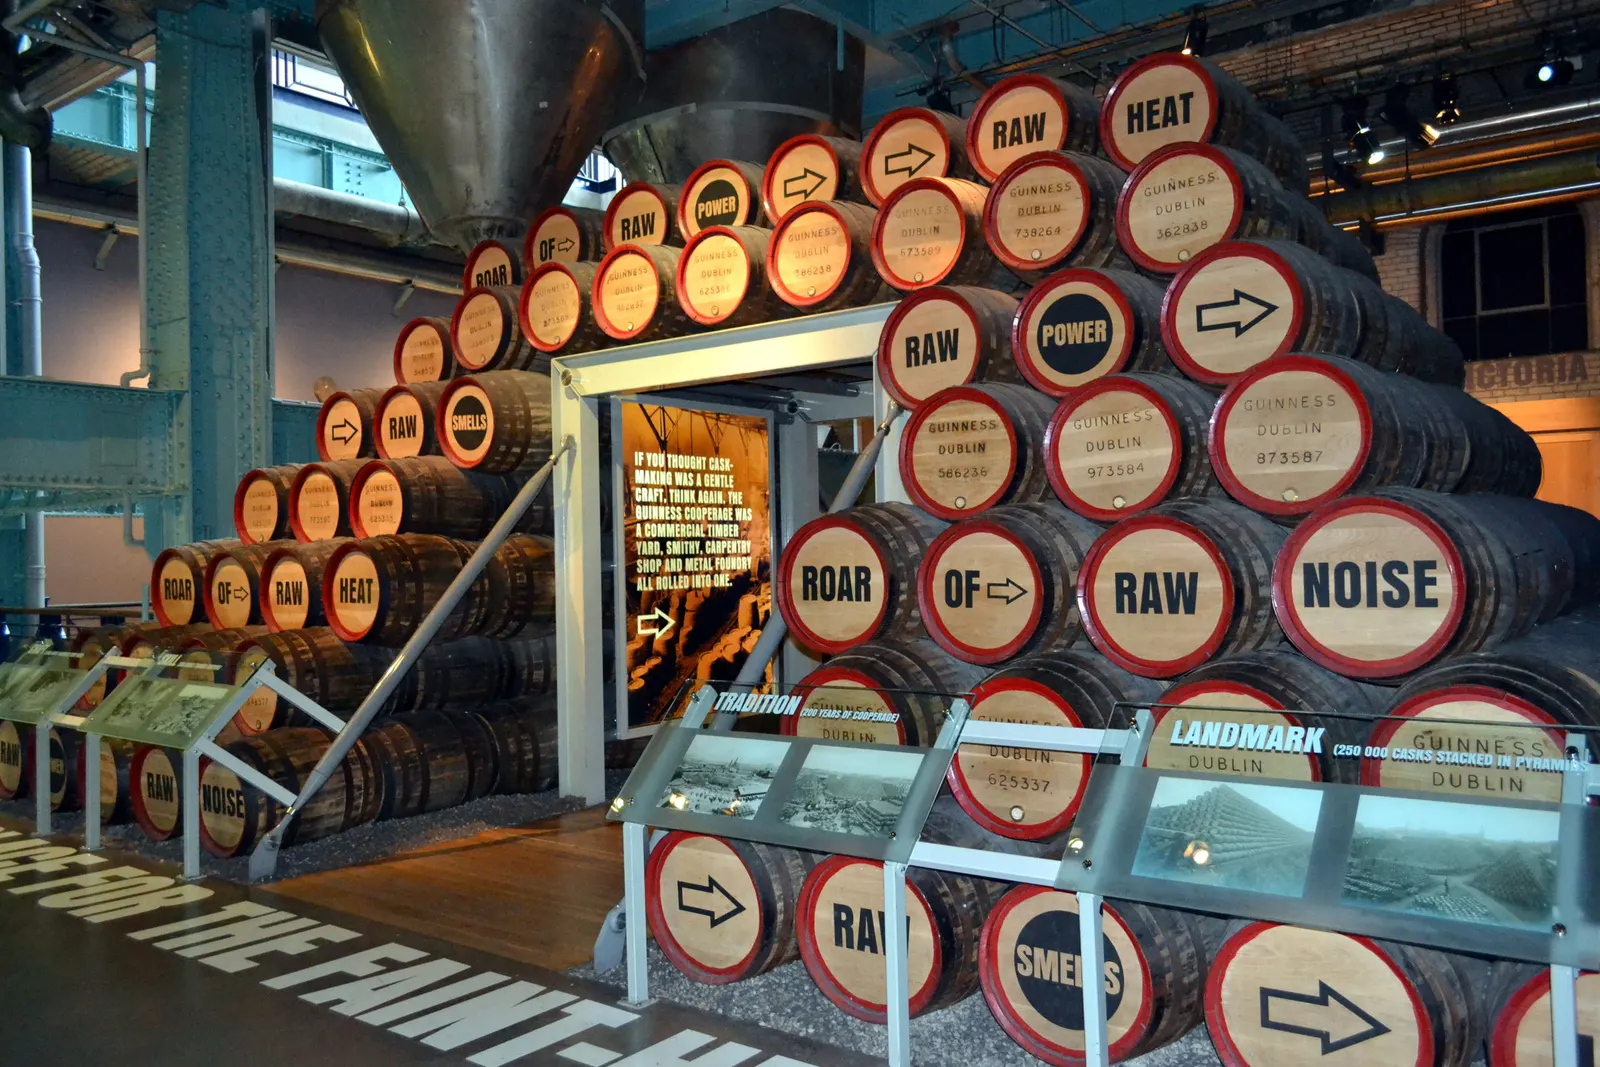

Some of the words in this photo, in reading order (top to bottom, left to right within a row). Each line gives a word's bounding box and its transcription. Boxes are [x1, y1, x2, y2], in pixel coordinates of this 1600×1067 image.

[1127, 91, 1195, 135] HEAT
[993, 112, 1047, 149] RAW
[1009, 182, 1073, 199] GUINNESS
[1144, 173, 1216, 198] GUINNESS
[697, 195, 736, 221] POWER
[894, 204, 950, 219] GUINNESS
[1017, 204, 1061, 217] DUBLIN
[1155, 197, 1206, 216] DUBLIN
[621, 211, 655, 241] RAW
[788, 229, 837, 243] GUINNESS
[901, 225, 940, 238] DUBLIN
[1015, 226, 1062, 239] 738264
[1156, 220, 1209, 241] 362838
[539, 238, 556, 262] OF
[694, 250, 738, 263] GUINNESS
[795, 246, 829, 259] DUBLIN
[900, 246, 942, 258] 673589
[476, 264, 508, 287] ROAR
[701, 268, 732, 279] DUBLIN
[1042, 319, 1108, 348] POWER
[904, 328, 960, 368] RAW
[1465, 351, 1589, 391] ICTORIA
[1243, 393, 1338, 412] GUINNESS
[389, 415, 417, 440] RAW
[451, 413, 487, 432] SMELLS
[928, 418, 998, 434] GUINNESS
[1073, 408, 1155, 431] GUINNESS
[1257, 420, 1323, 437] DUBLIN
[938, 441, 987, 456] DUBLIN
[1086, 435, 1142, 453] DUBLIN
[634, 451, 644, 466] IF
[646, 452, 664, 467] YOU
[667, 454, 707, 470] THOUGHT
[709, 457, 734, 472] CASK-
[1256, 449, 1325, 466] 873587
[634, 469, 672, 485] MAKING
[674, 472, 694, 486] WAS
[696, 472, 702, 487] A
[704, 474, 734, 488] GENTLE
[937, 465, 989, 480] 586236
[1086, 461, 1146, 480] 973584
[669, 489, 696, 503] THINK
[728, 491, 742, 504] THE
[636, 506, 682, 520] GUINNESS
[684, 506, 733, 520] COOPERAGE
[735, 508, 752, 521] WAS
[636, 523, 642, 538] A
[644, 524, 706, 538] COMMERCIAL
[707, 524, 739, 538] TIMBER
[705, 540, 752, 554] CARPENTRY
[636, 558, 662, 573] SHOP
[664, 558, 683, 572] AND
[685, 557, 713, 572] METAL
[715, 556, 752, 570] FOUNDRY
[164, 578, 192, 601] ROAR
[276, 580, 303, 606] RAW
[339, 577, 374, 605] HEAT
[636, 576, 654, 591] ALL
[656, 576, 690, 590] ROLLED
[692, 574, 712, 588] INTO
[714, 574, 733, 587] ONE.
[801, 564, 872, 603] ROAR
[943, 569, 981, 610] OF
[1114, 570, 1199, 616] RAW
[1303, 558, 1439, 609] NOISE
[218, 582, 232, 605] OF
[714, 691, 803, 716] TRADITION
[800, 707, 819, 718] (200
[818, 708, 841, 720] YEARS
[841, 711, 853, 720] OF
[853, 711, 900, 724] COOPERAGE)
[990, 745, 1052, 764] DUBLIN
[1170, 719, 1326, 755] LANDMARK
[1333, 744, 1362, 758] (250
[1364, 747, 1388, 760] 000
[1392, 747, 1434, 763] CASKS
[1436, 751, 1494, 767] STACKED
[1497, 755, 1512, 770] IN
[1412, 734, 1545, 758] GUINNESS
[1188, 754, 1264, 774] DUBLIN
[146, 771, 174, 804] RAW
[1432, 770, 1525, 793] DUBLIN
[202, 783, 245, 819] NOISE
[6, 865, 215, 924] FOR
[126, 901, 363, 974] THE
[1016, 943, 1121, 995] SMELS
